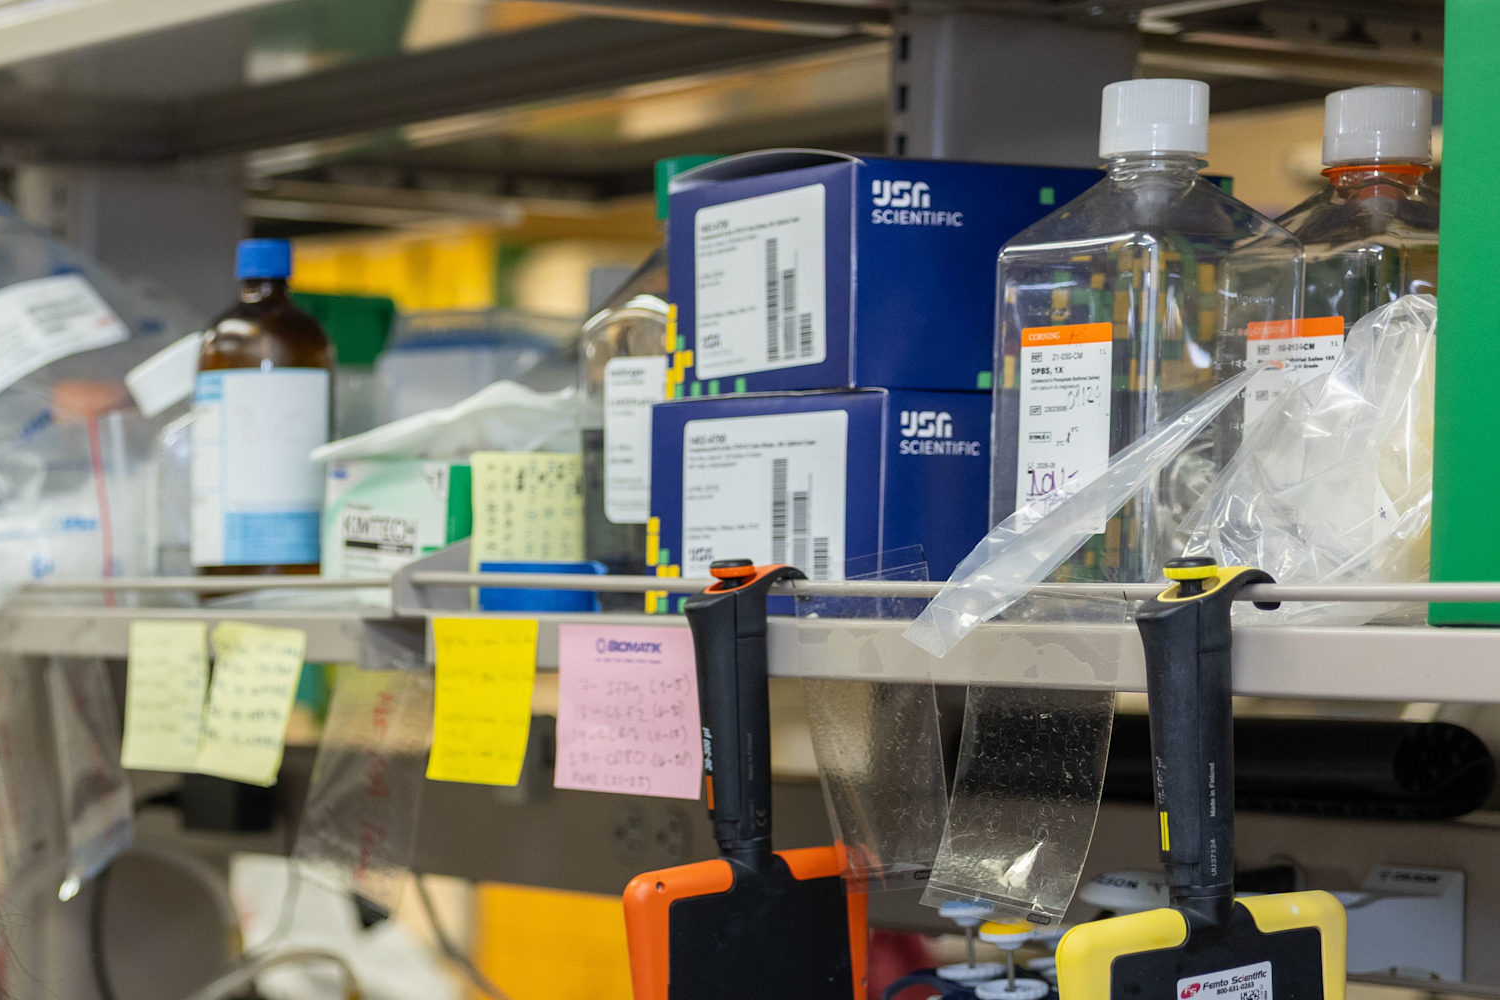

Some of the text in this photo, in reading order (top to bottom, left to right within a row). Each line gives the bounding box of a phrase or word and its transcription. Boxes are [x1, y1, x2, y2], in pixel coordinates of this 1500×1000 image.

[871, 179, 931, 209] USA
[871, 208, 964, 227] SCIENTIFIC
[1028, 331, 1060, 341] CORNING
[1031, 366, 1064, 375] DPBS, 1X
[900, 410, 953, 438] USA
[899, 439, 981, 456] SCIENTIFIC
[1208, 763, 1216, 789] Finland
[1210, 838, 1218, 877] UU37124
[1203, 980, 1229, 991] Femto
[1231, 970, 1268, 985] Scientific
[1216, 981, 1255, 995] 800-631-0263
